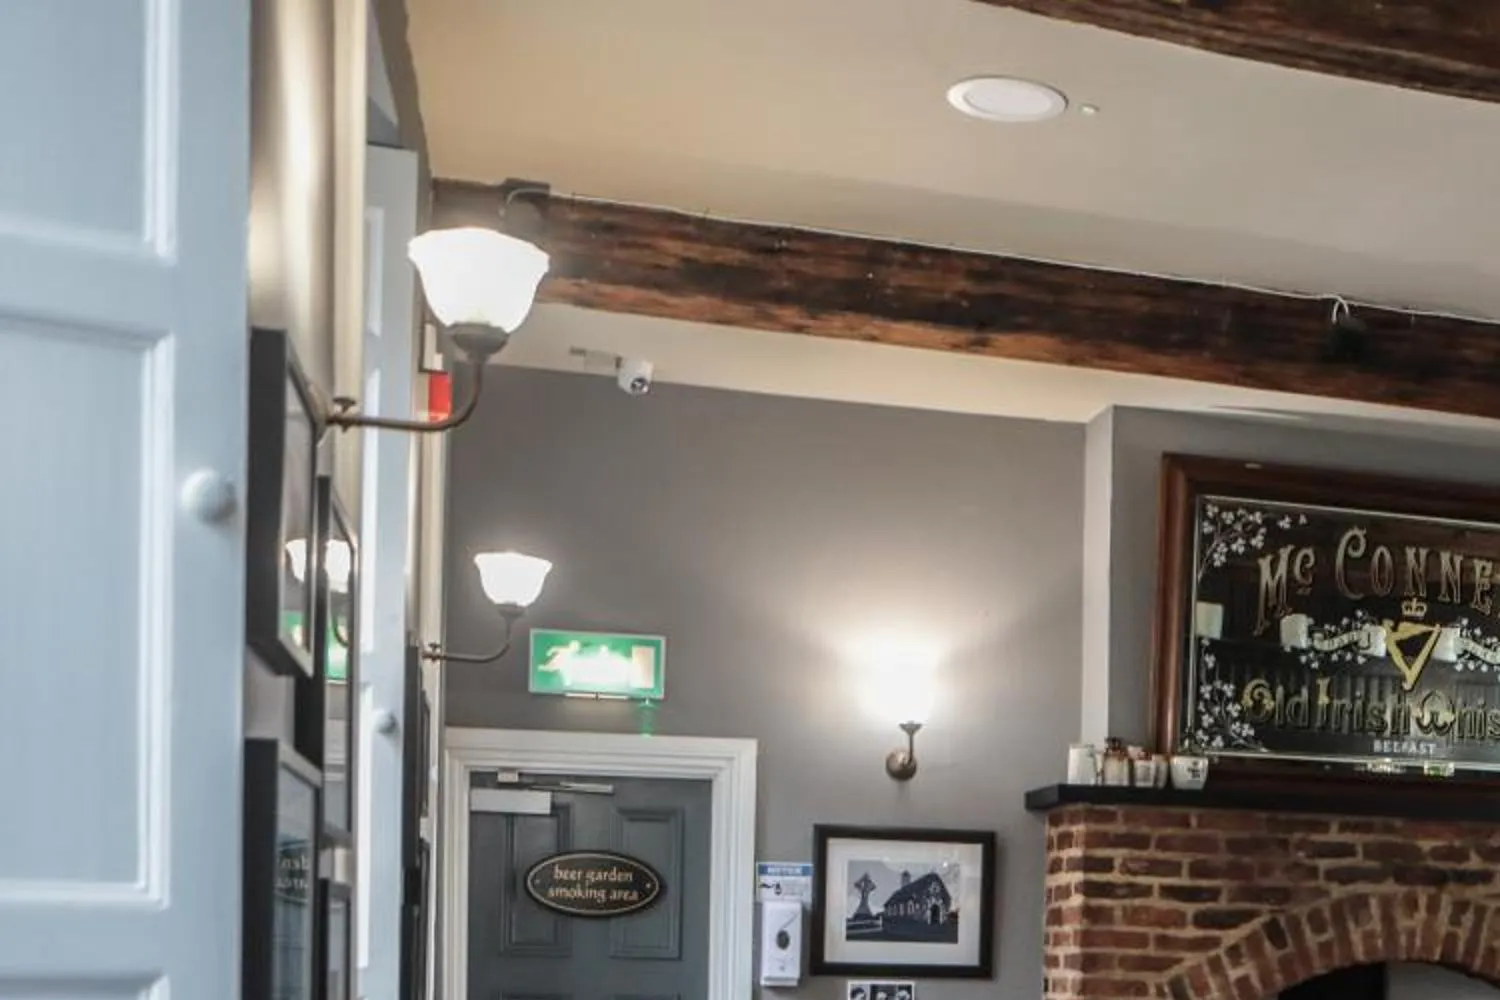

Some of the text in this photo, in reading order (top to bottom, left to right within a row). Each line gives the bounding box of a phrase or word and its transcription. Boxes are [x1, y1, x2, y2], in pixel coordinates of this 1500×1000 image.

[1241, 678, 1309, 728] Old
[1315, 677, 1411, 735] Irish
[1374, 740, 1437, 755] BELFAST
[553, 864, 632, 882] beer garden
[547, 883, 639, 904] smoking area
